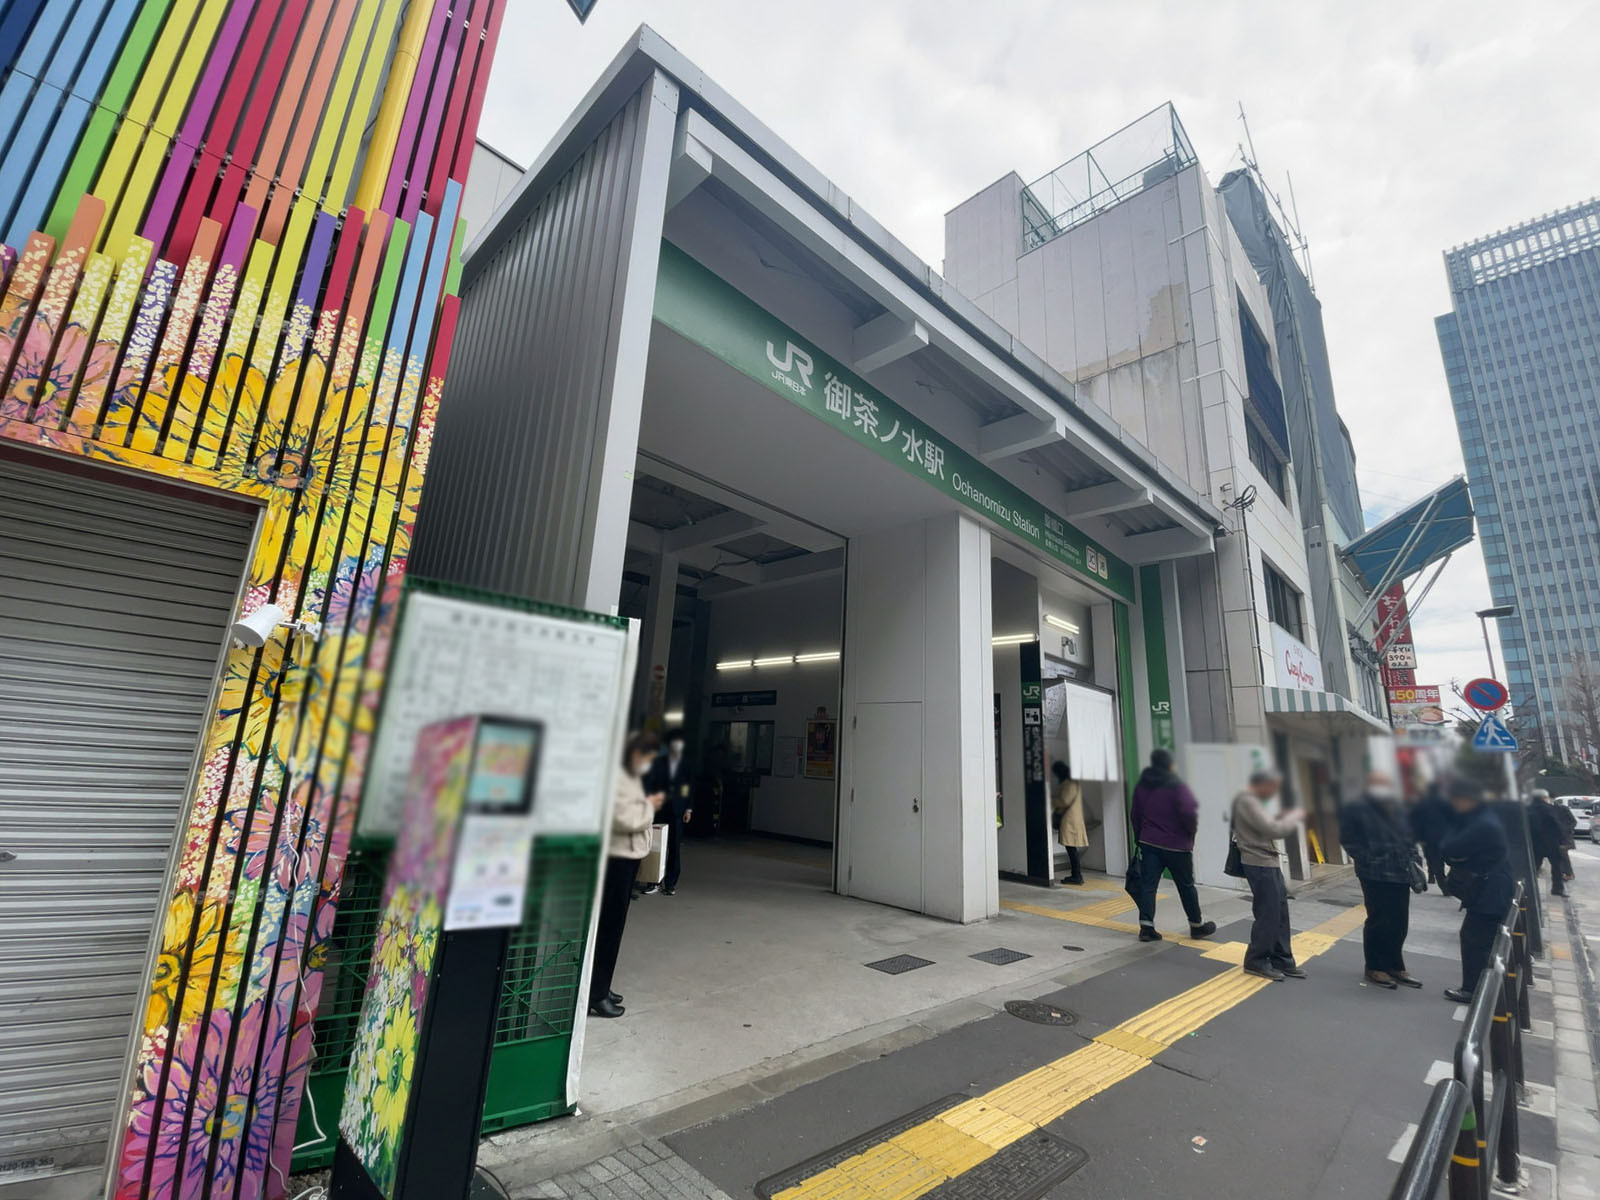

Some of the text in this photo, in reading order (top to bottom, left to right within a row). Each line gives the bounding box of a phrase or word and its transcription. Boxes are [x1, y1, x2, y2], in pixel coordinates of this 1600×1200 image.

[766, 340, 814, 389] JR
[823, 371, 945, 480] 御茶ノ水駅
[952, 472, 1011, 521] Ochanomizu
[1012, 510, 1040, 539] Station
[1023, 685, 1040, 696] JR
[1152, 701, 1170, 711] JR
